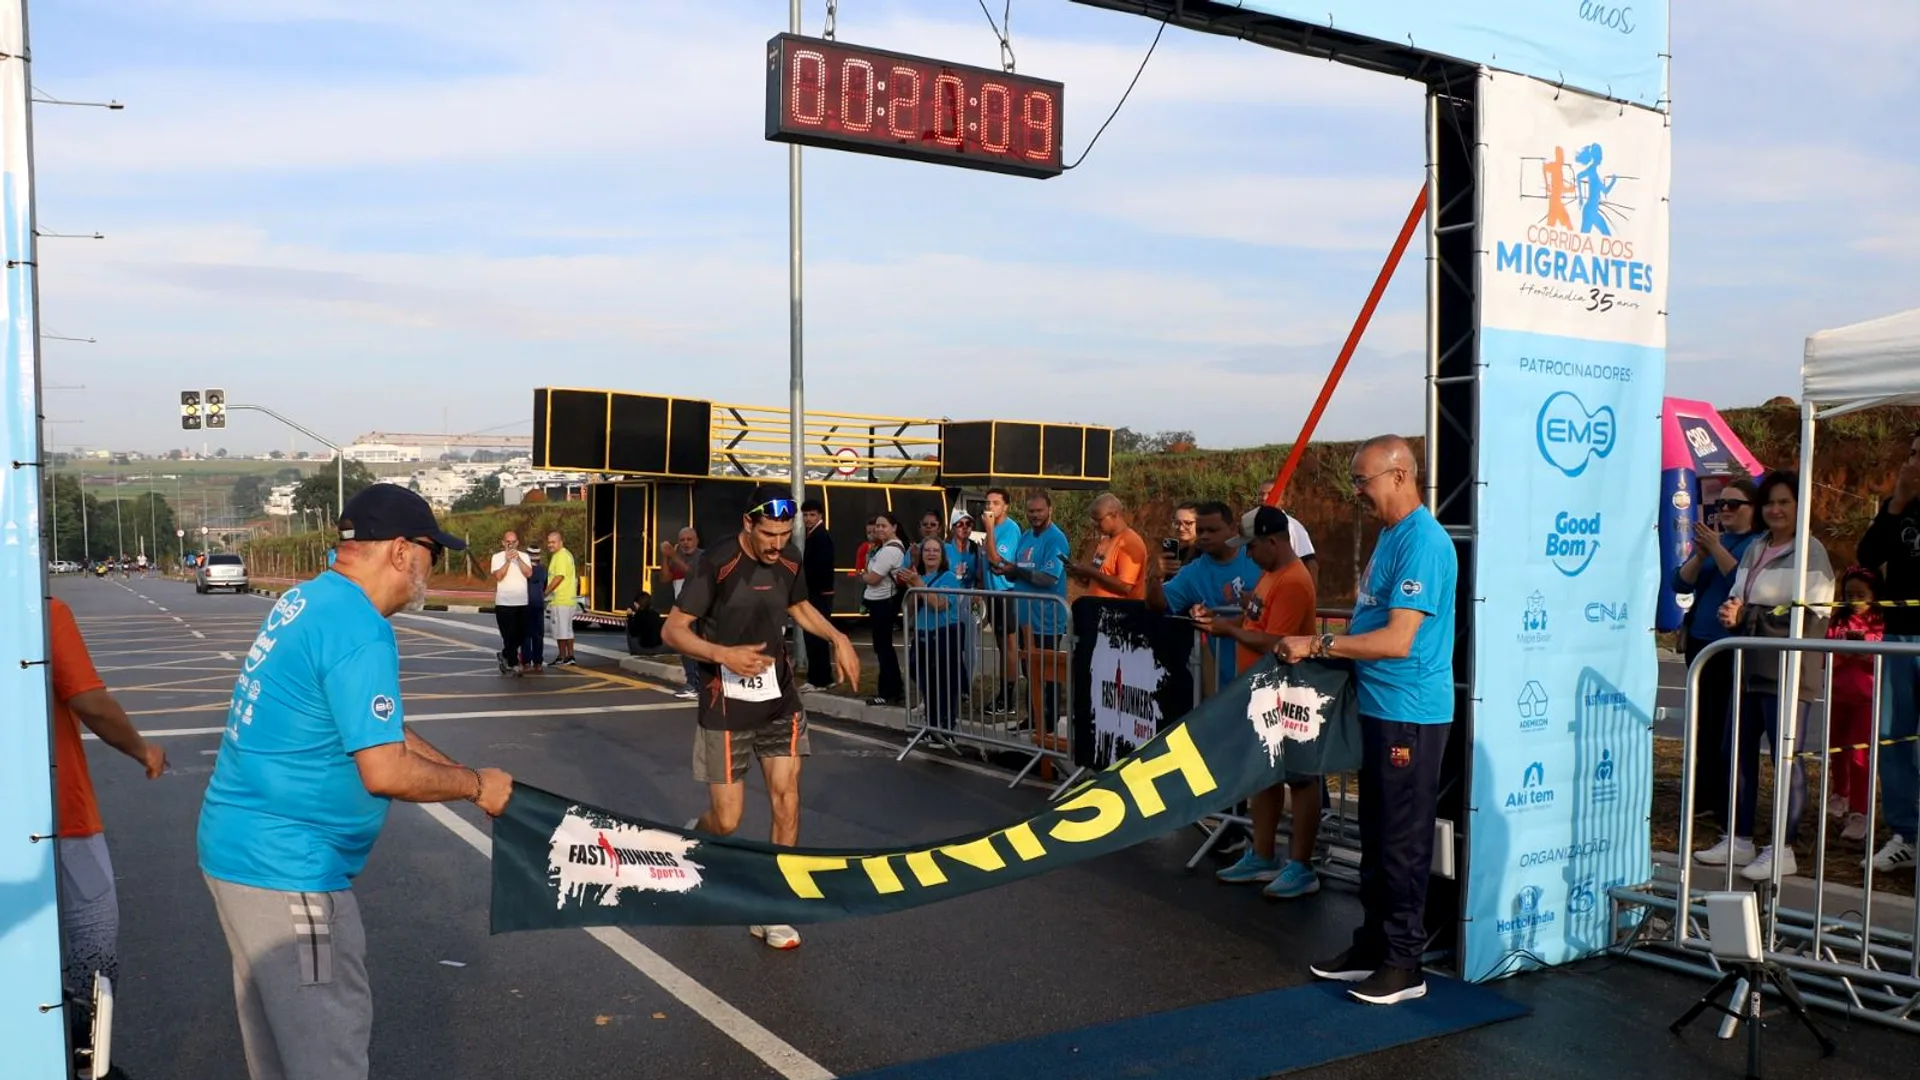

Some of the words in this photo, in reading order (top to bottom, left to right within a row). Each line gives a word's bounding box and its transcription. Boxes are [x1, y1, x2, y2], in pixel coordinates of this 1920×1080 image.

[1579, 0, 1636, 34] anos
[791, 49, 1053, 160] 00:20:09
[1527, 224, 1594, 255] CORRIDA
[1601, 236, 1634, 259] DOS
[1496, 240, 1653, 294] MIGRANTES
[1586, 287, 1615, 313] 35
[1519, 356, 1633, 383] PATROCINADORES:
[1546, 418, 1609, 446] EMS
[1555, 511, 1601, 535] Good
[1545, 533, 1586, 557] Bom
[1584, 602, 1629, 623] CNA
[738, 676, 763, 690] 143
[1281, 700, 1310, 723] NERS
[1519, 717, 1548, 729] ADEMICON
[1505, 793, 1527, 808] Aki
[1530, 788, 1554, 804] tem
[568, 843, 606, 866] FAST
[617, 847, 677, 868] RUNNERS
[649, 866, 686, 880] Sports
